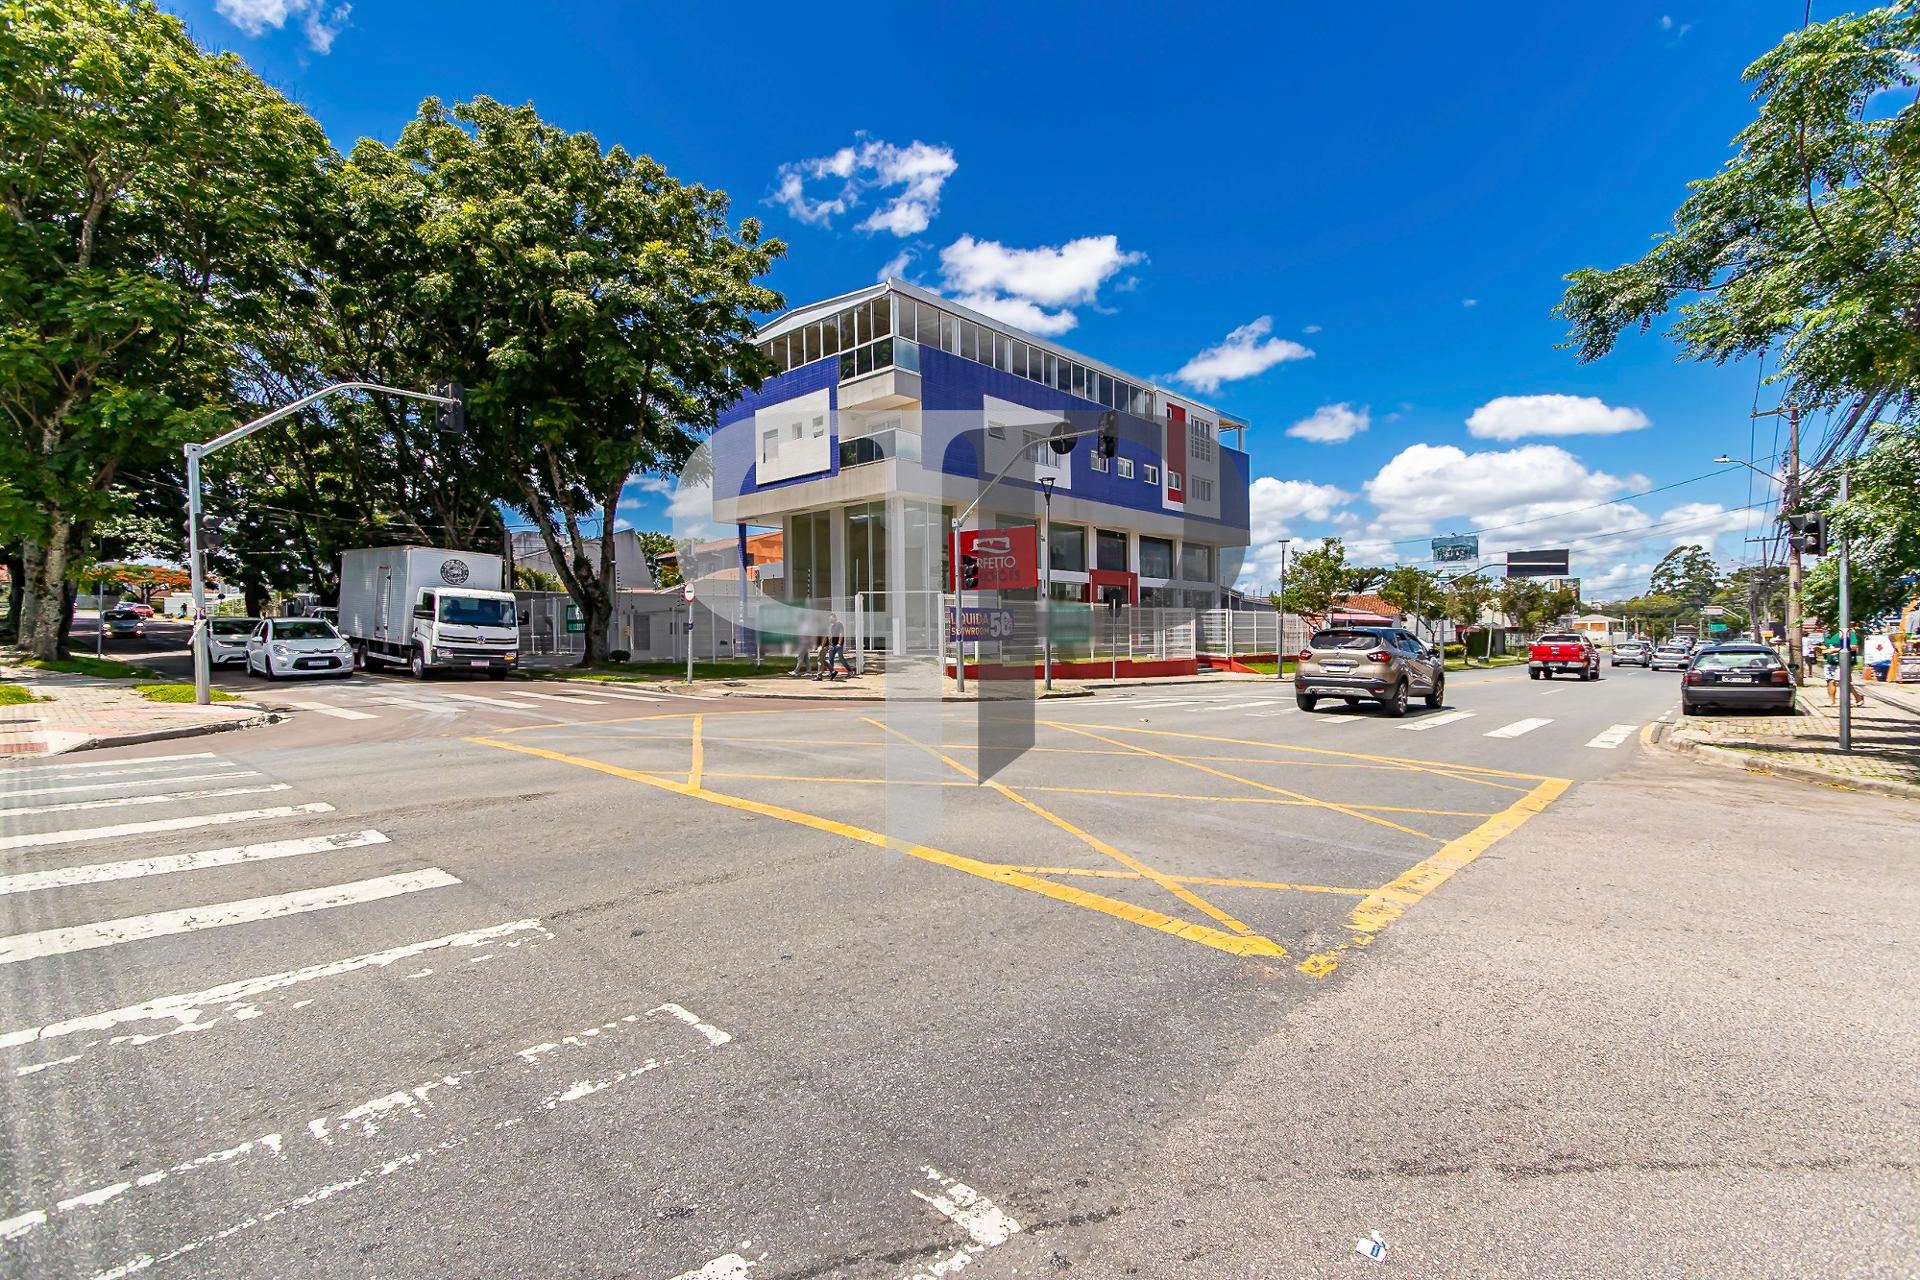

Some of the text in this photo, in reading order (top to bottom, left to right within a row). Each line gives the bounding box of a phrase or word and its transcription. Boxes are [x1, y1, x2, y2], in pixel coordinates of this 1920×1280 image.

[976, 556, 1016, 569] RFETTO
[950, 612, 989, 625] LQUIDA
[951, 627, 990, 636] SOWROOM
